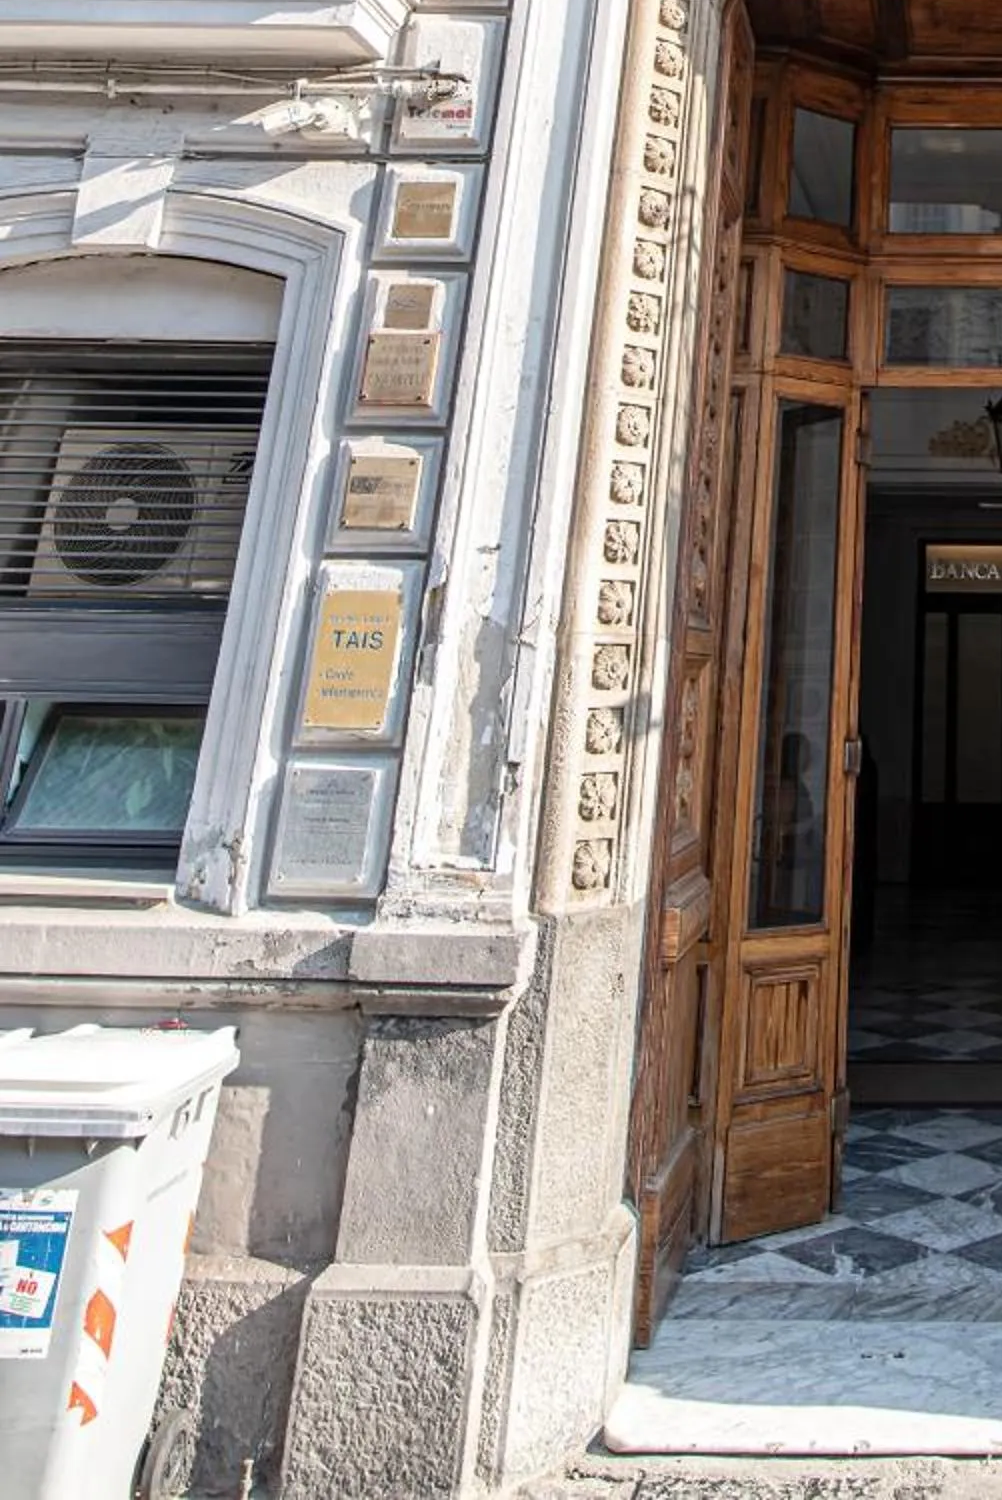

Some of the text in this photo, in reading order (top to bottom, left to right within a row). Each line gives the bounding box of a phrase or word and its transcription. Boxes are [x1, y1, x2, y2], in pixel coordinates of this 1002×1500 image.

[929, 560, 1000, 580] BANCA
[333, 628, 384, 650] TAIS
[16, 1278, 38, 1295] NO
